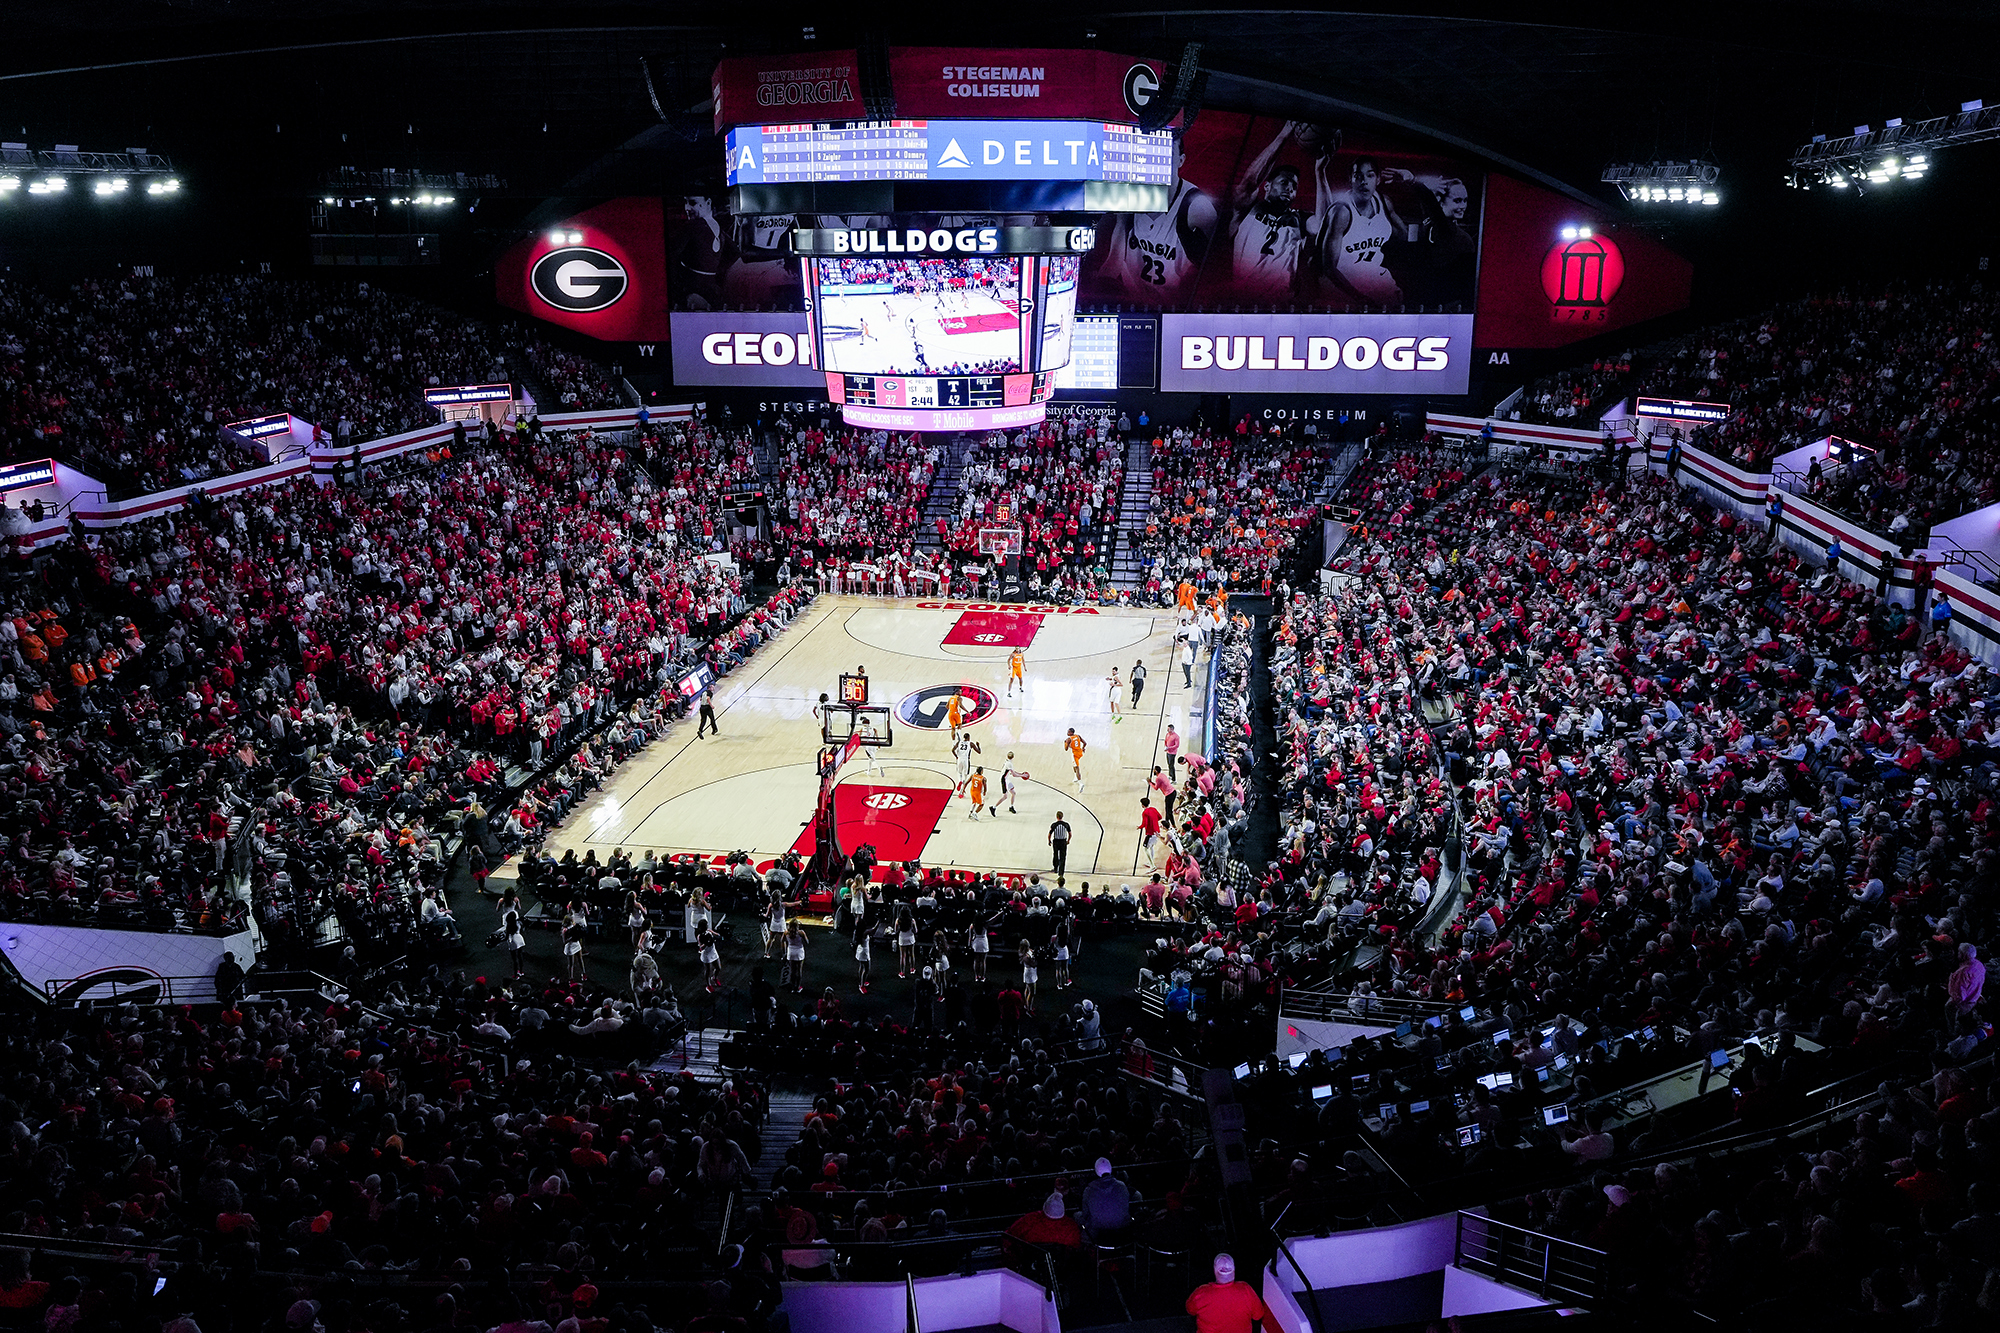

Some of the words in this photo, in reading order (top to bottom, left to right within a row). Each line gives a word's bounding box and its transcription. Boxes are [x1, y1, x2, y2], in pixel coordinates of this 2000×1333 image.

[758, 67, 832, 82] UNIVERSITY
[834, 66, 850, 78] OF
[942, 66, 1044, 80] STEGEMAN
[757, 80, 854, 106] GEORGIA
[947, 84, 1040, 98] COLISEUM
[738, 145, 756, 169] A
[983, 140, 1100, 166] DELTA
[766, 230, 775, 246] 1
[833, 229, 998, 253] BULLDOGS
[1260, 231, 1278, 255] 2
[1141, 255, 1166, 285] 23
[1553, 308, 1606, 320] 1785
[638, 345, 655, 356] YY
[1181, 336, 1451, 371] BULLDOGS
[1488, 352, 1510, 364] AA
[948, 381, 959, 392] T
[461, 391, 510, 400] BASKETBALL
[885, 394, 896, 404] 32
[911, 397, 933, 406] 2:44
[948, 395, 960, 405] 42
[1063, 404, 1075, 416] of
[1076, 404, 1117, 416] Georgia
[871, 413, 891, 424] ACROSS
[891, 415, 902, 425] THE
[903, 415, 914, 425] SEC
[943, 412, 974, 428] Mobile
[996, 511, 1009, 520] 30
[916, 602, 1100, 615] GEORGIA
[974, 633, 1006, 642] SEC
[846, 687, 861, 700] 30
[865, 793, 909, 809] SEC
